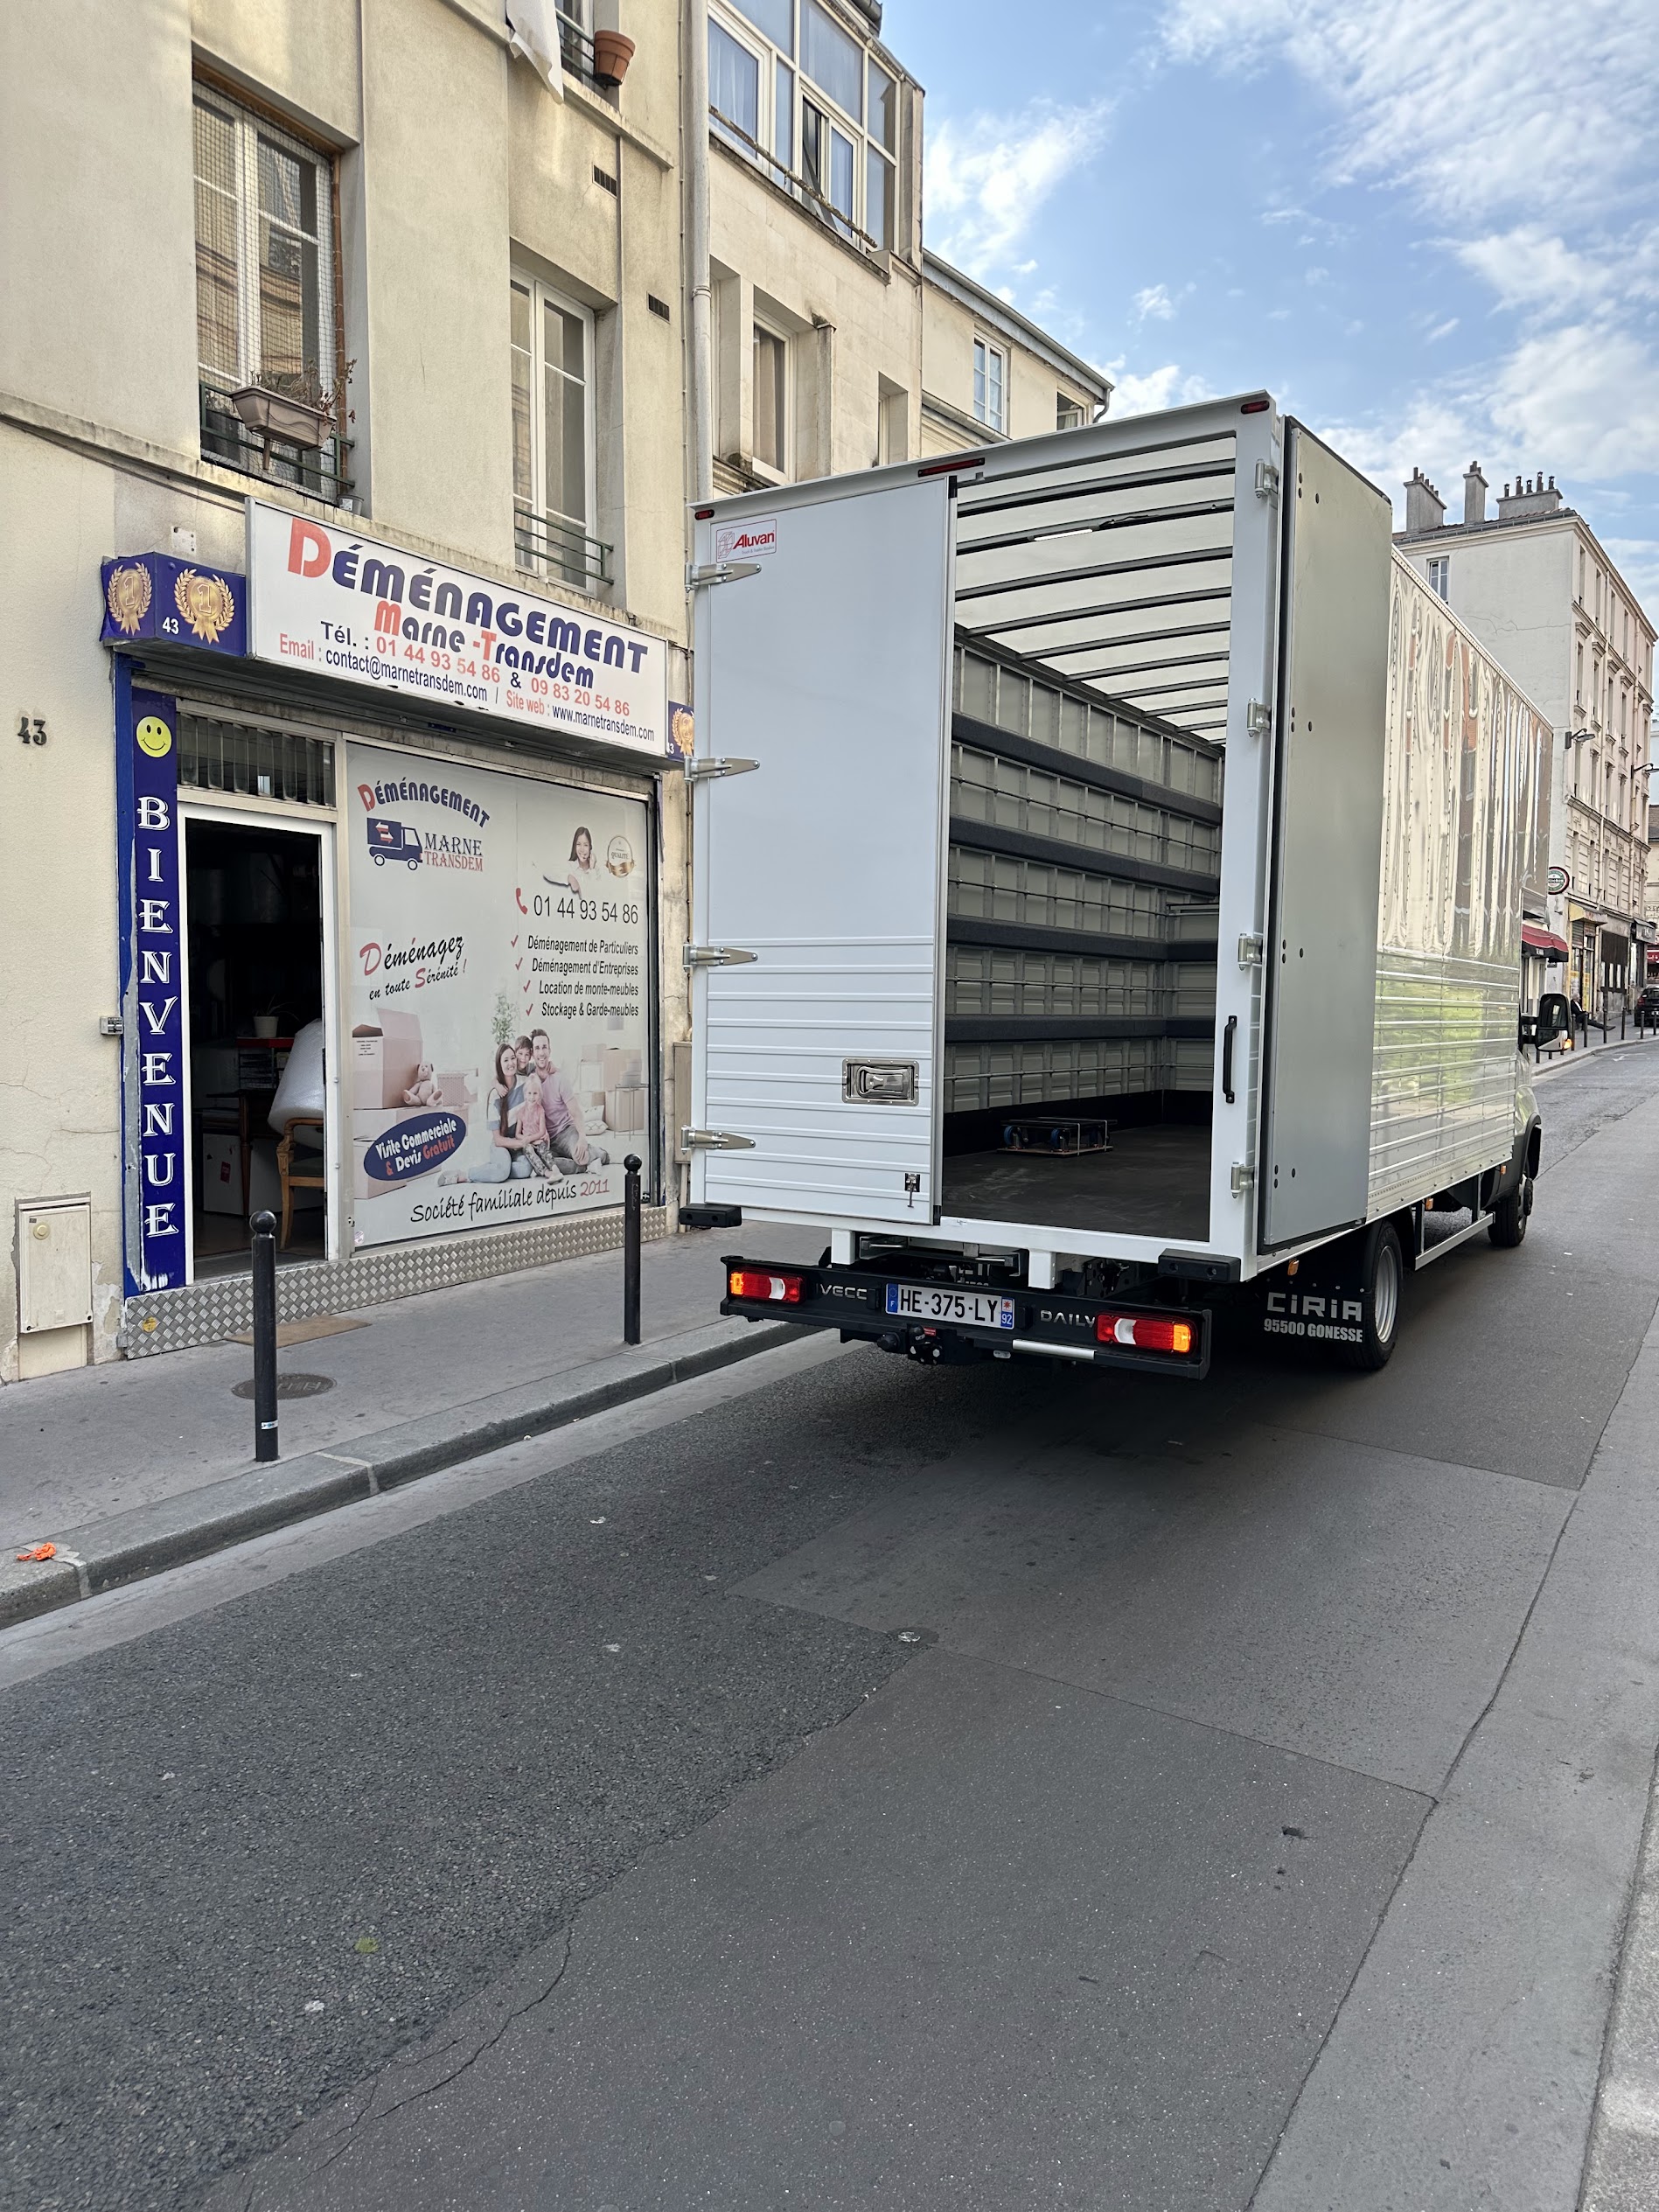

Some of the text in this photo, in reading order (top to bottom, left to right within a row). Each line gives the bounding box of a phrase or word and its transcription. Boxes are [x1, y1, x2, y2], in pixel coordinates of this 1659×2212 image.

[733, 532, 775, 549] Aluvan
[288, 517, 648, 673] DÉMÉNAGEMENT
[162, 617, 179, 634] 43
[374, 600, 465, 652] Marne
[320, 621, 357, 647] Tél.
[376, 637, 396, 656] 01
[404, 644, 425, 664] 44
[430, 651, 451, 670] 93
[457, 658, 477, 677] 54
[482, 664, 500, 683] 86
[511, 672, 521, 689] &
[531, 677, 548, 695] 09
[553, 683, 569, 701] 83
[575, 688, 590, 707] 20
[596, 694, 610, 712] 54
[615, 700, 630, 716] 86
[280, 633, 315, 660] Email
[325, 649, 488, 701] contact@marnetransdem.com
[506, 689, 524, 709] Site
[526, 697, 545, 715] web
[552, 704, 655, 742] www.marnetransdem.com
[17, 716, 47, 745] 43
[357, 777, 490, 828] DÉMÉNAGEMENT
[424, 832, 484, 856] MARNE
[424, 850, 484, 872] TRANSDEM
[533, 895, 638, 925] 01 44 93 54 86
[359, 936, 464, 976] Déménagez
[527, 935, 638, 955] Déménagement de Particuliers
[369, 989, 380, 1001] en
[385, 978, 410, 996] toute
[415, 961, 459, 988] Sérénité
[532, 957, 638, 978] Déménagement d'Entreprises
[539, 980, 639, 995] Location de monte-meubles
[136, 795, 179, 1239] BIENVENUE
[541, 1001, 639, 1020] Stockage & Garde-meubles
[375, 1118, 457, 1160] Visite Commerciale
[386, 1134, 455, 1176] & Devis Gratuit
[410, 1179, 610, 1222] Société familiale depuis 2011
[900, 1288, 999, 1322] HE-375-LY
[1001, 1312, 1013, 1325] 92
[1040, 1310, 1096, 1328] DAILY
[1264, 1318, 1363, 1343] 95500 GONESSE
